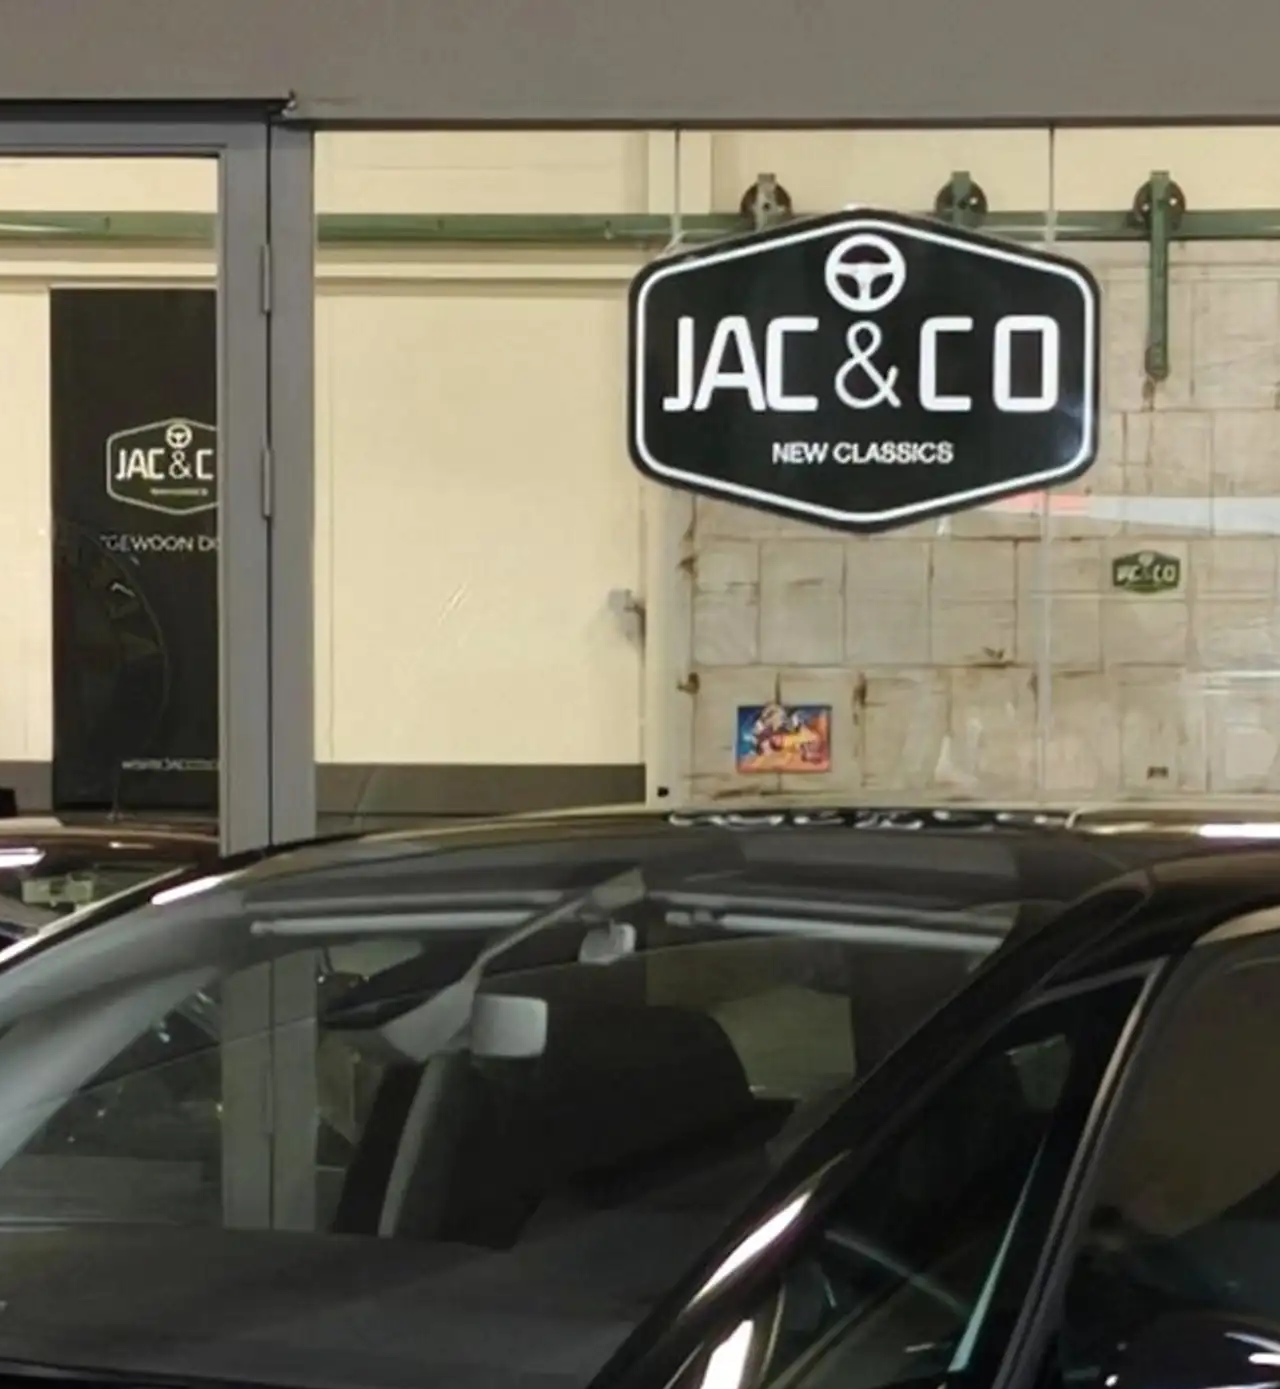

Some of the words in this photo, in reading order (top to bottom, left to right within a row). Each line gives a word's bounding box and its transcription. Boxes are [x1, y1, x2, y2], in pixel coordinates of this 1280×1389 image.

[114, 447, 166, 481] JAC
[772, 442, 827, 464] NEW
[832, 441, 954, 465] CLASSICS
